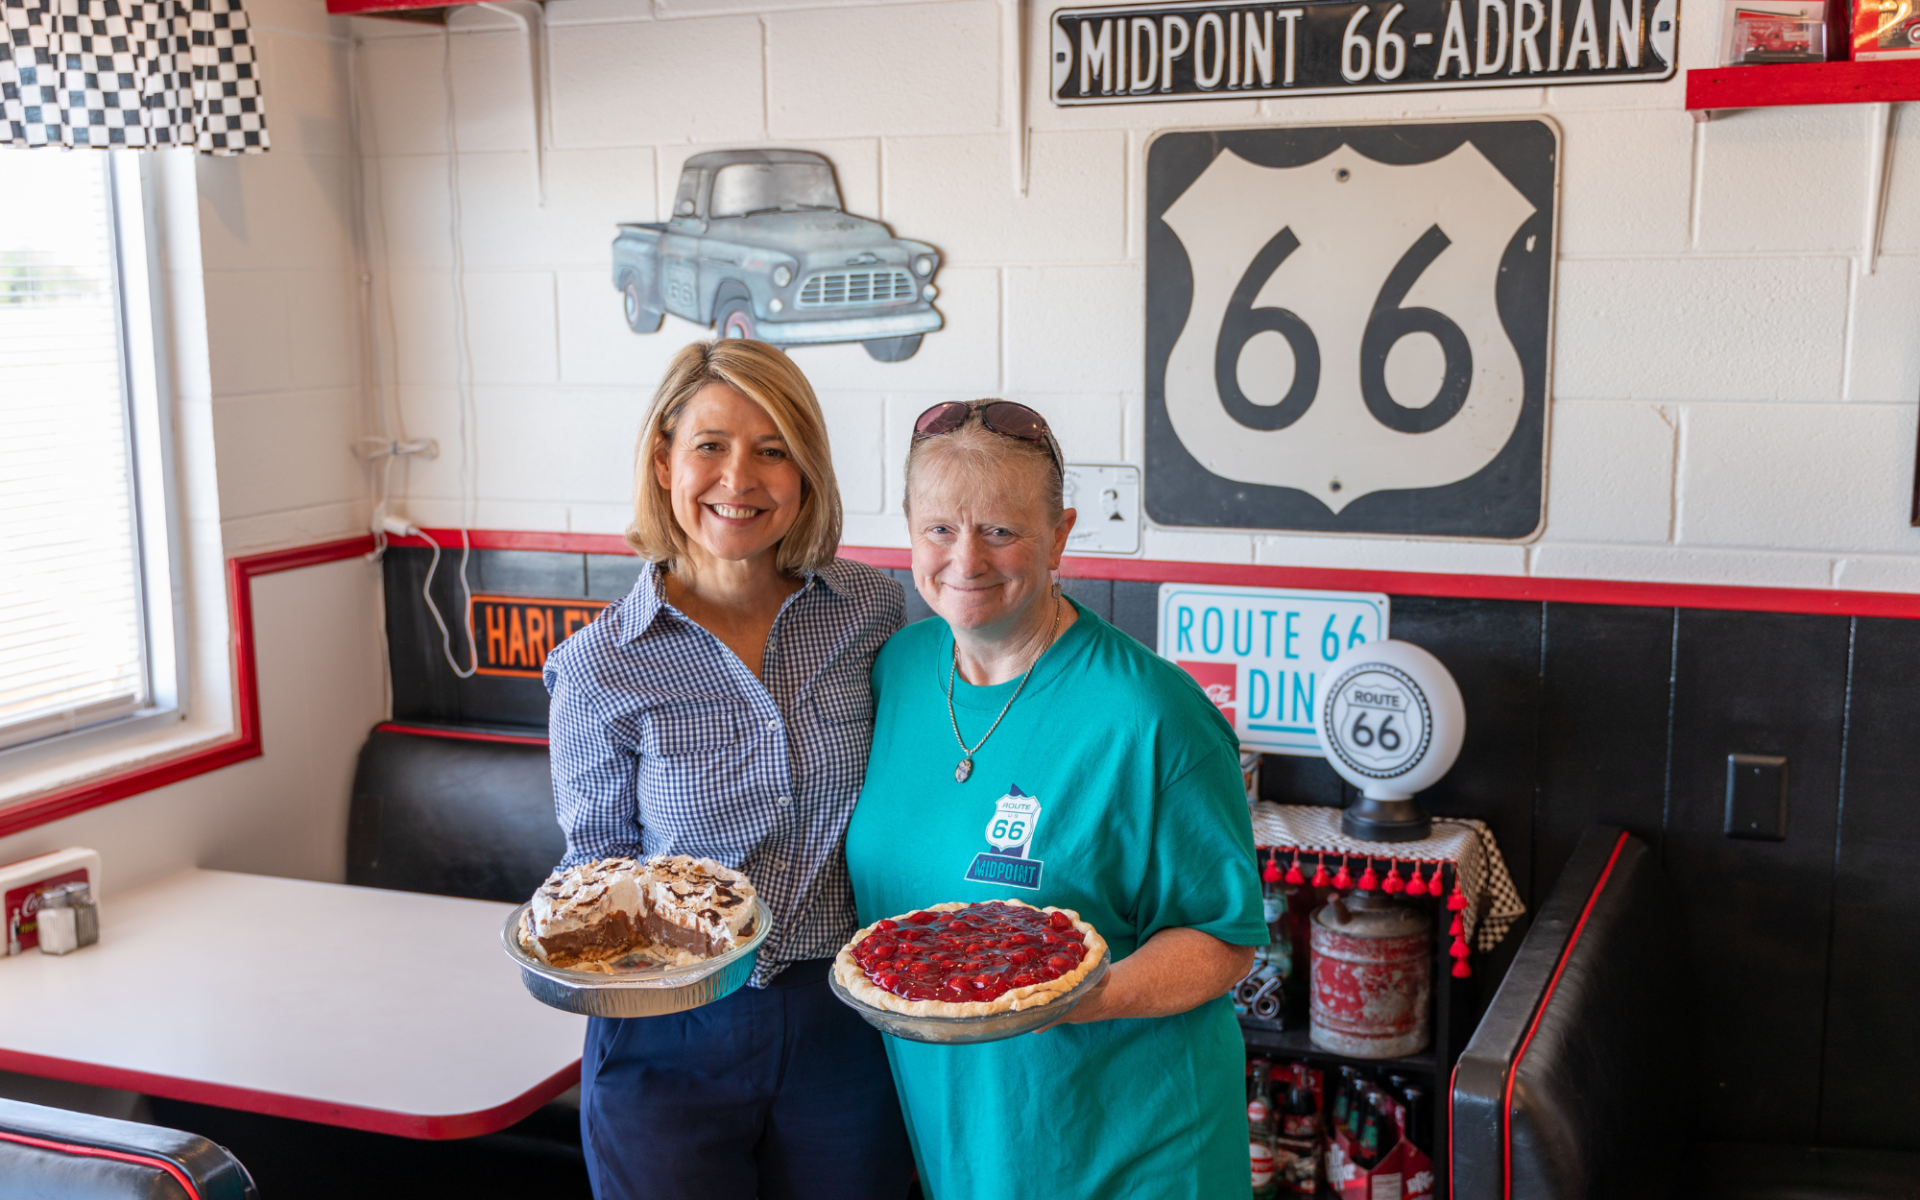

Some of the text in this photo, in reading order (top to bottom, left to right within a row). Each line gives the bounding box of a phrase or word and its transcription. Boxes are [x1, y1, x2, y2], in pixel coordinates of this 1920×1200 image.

[1079, 0, 1643, 95] MIDPOINT 66-ADRIAN
[668, 281, 697, 304] 66
[1214, 222, 1474, 434] 66
[1177, 606, 1366, 662] ROUTE 66
[1248, 668, 1316, 724] DIN
[1354, 690, 1400, 707] ROUTE
[1352, 711, 1401, 751] 66
[1002, 802, 1031, 811] ROUTE
[992, 819, 1025, 840] 66
[974, 859, 1036, 884] MIDPOINT
[1237, 961, 1282, 1020] 66
